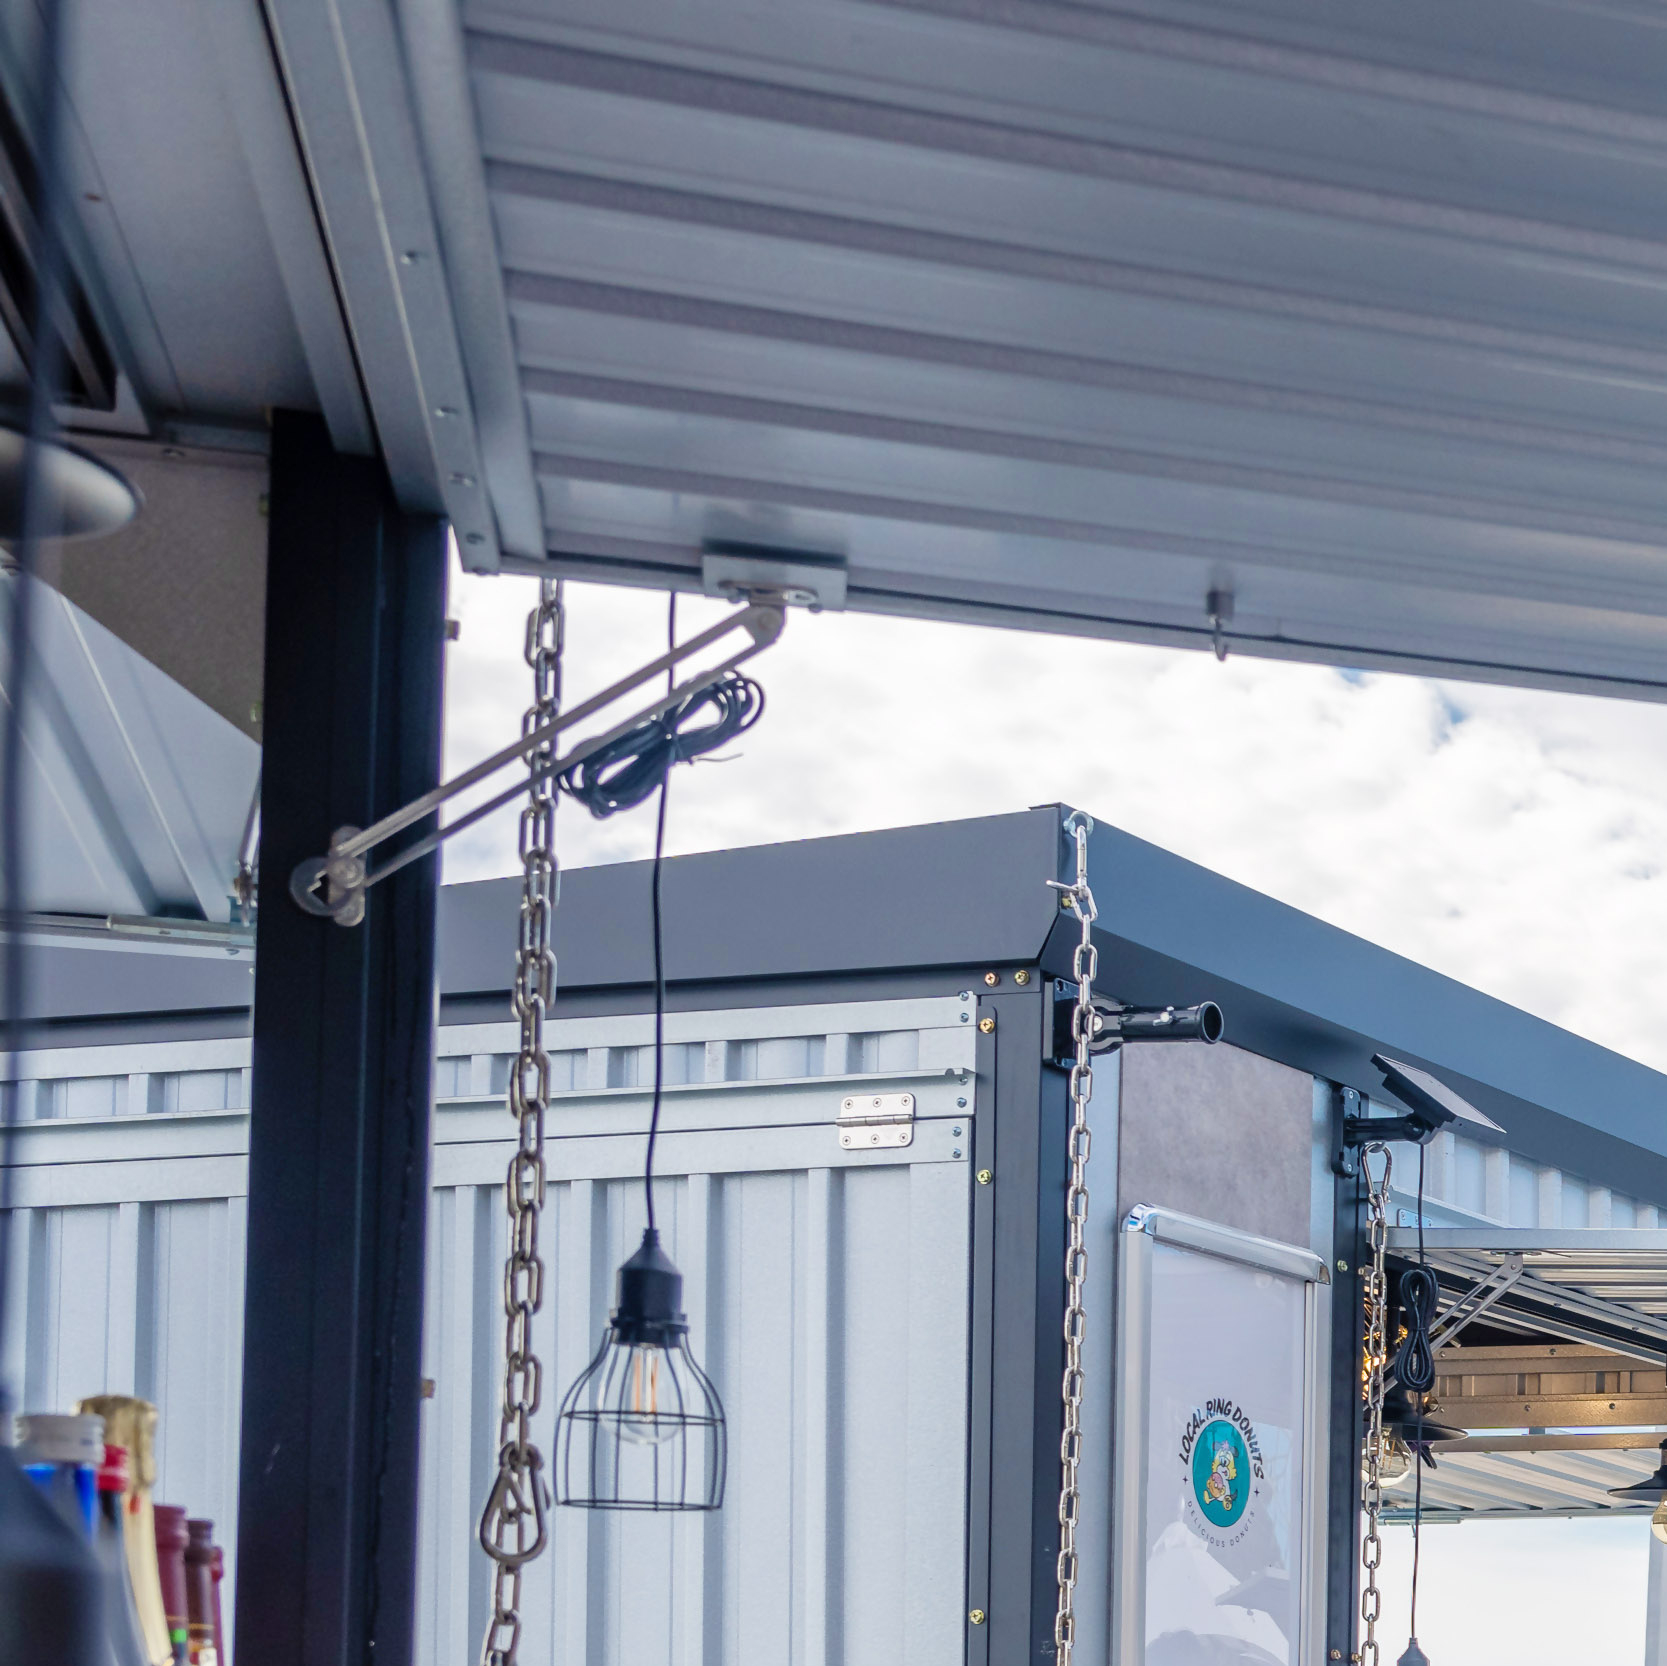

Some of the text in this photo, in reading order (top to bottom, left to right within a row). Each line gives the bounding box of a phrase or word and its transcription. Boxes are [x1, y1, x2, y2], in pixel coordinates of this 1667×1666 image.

[1179, 1397, 1264, 1480] LOCAL RING DONUTS
[1188, 1500, 1256, 1548] DELICIOUS DONUTS
